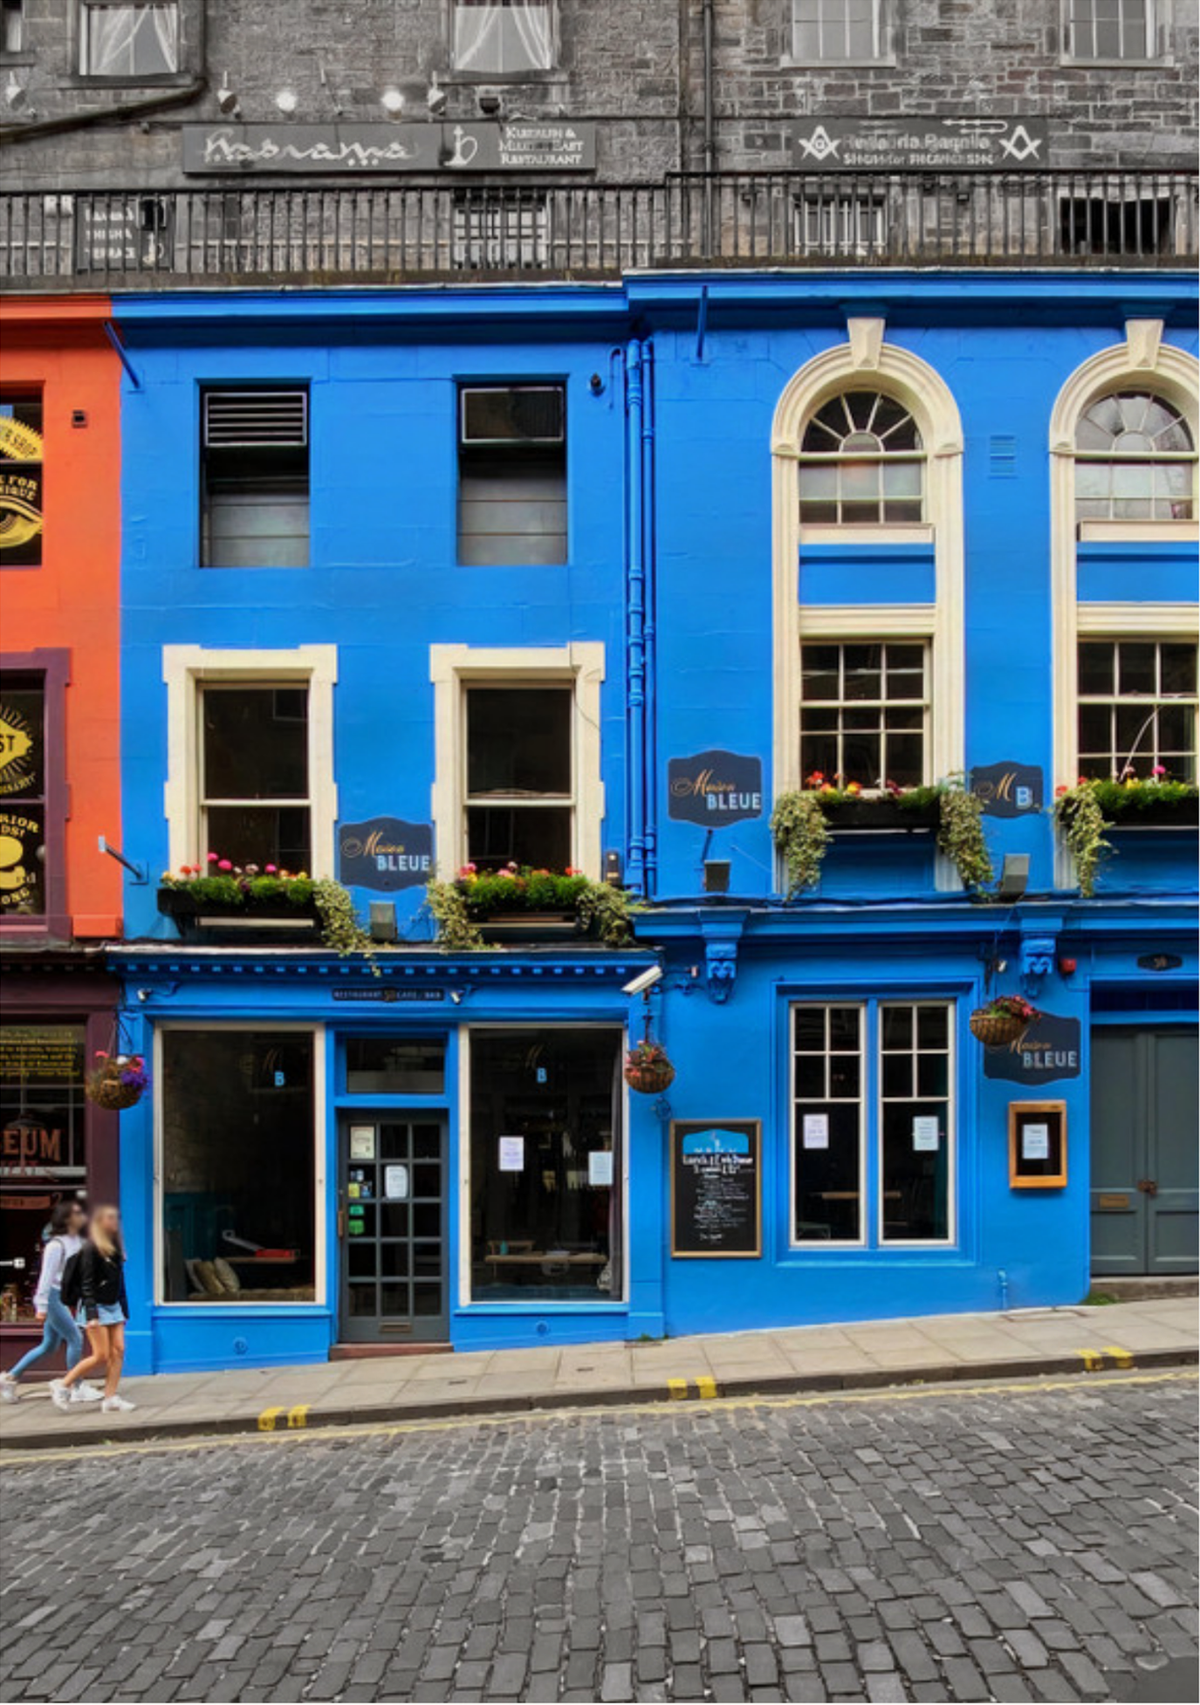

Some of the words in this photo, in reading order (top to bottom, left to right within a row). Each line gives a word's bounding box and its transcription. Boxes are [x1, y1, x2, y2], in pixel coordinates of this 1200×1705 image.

[501, 152, 582, 165] RESTAURANT
[706, 792, 761, 810] BLEUE
[1015, 786, 1034, 810] B
[377, 854, 430, 872] BLEUE
[1023, 1050, 1077, 1069] BLEUE
[275, 1071, 285, 1086] B
[537, 1067, 547, 1083] B
[3, 1127, 62, 1162] EUM
